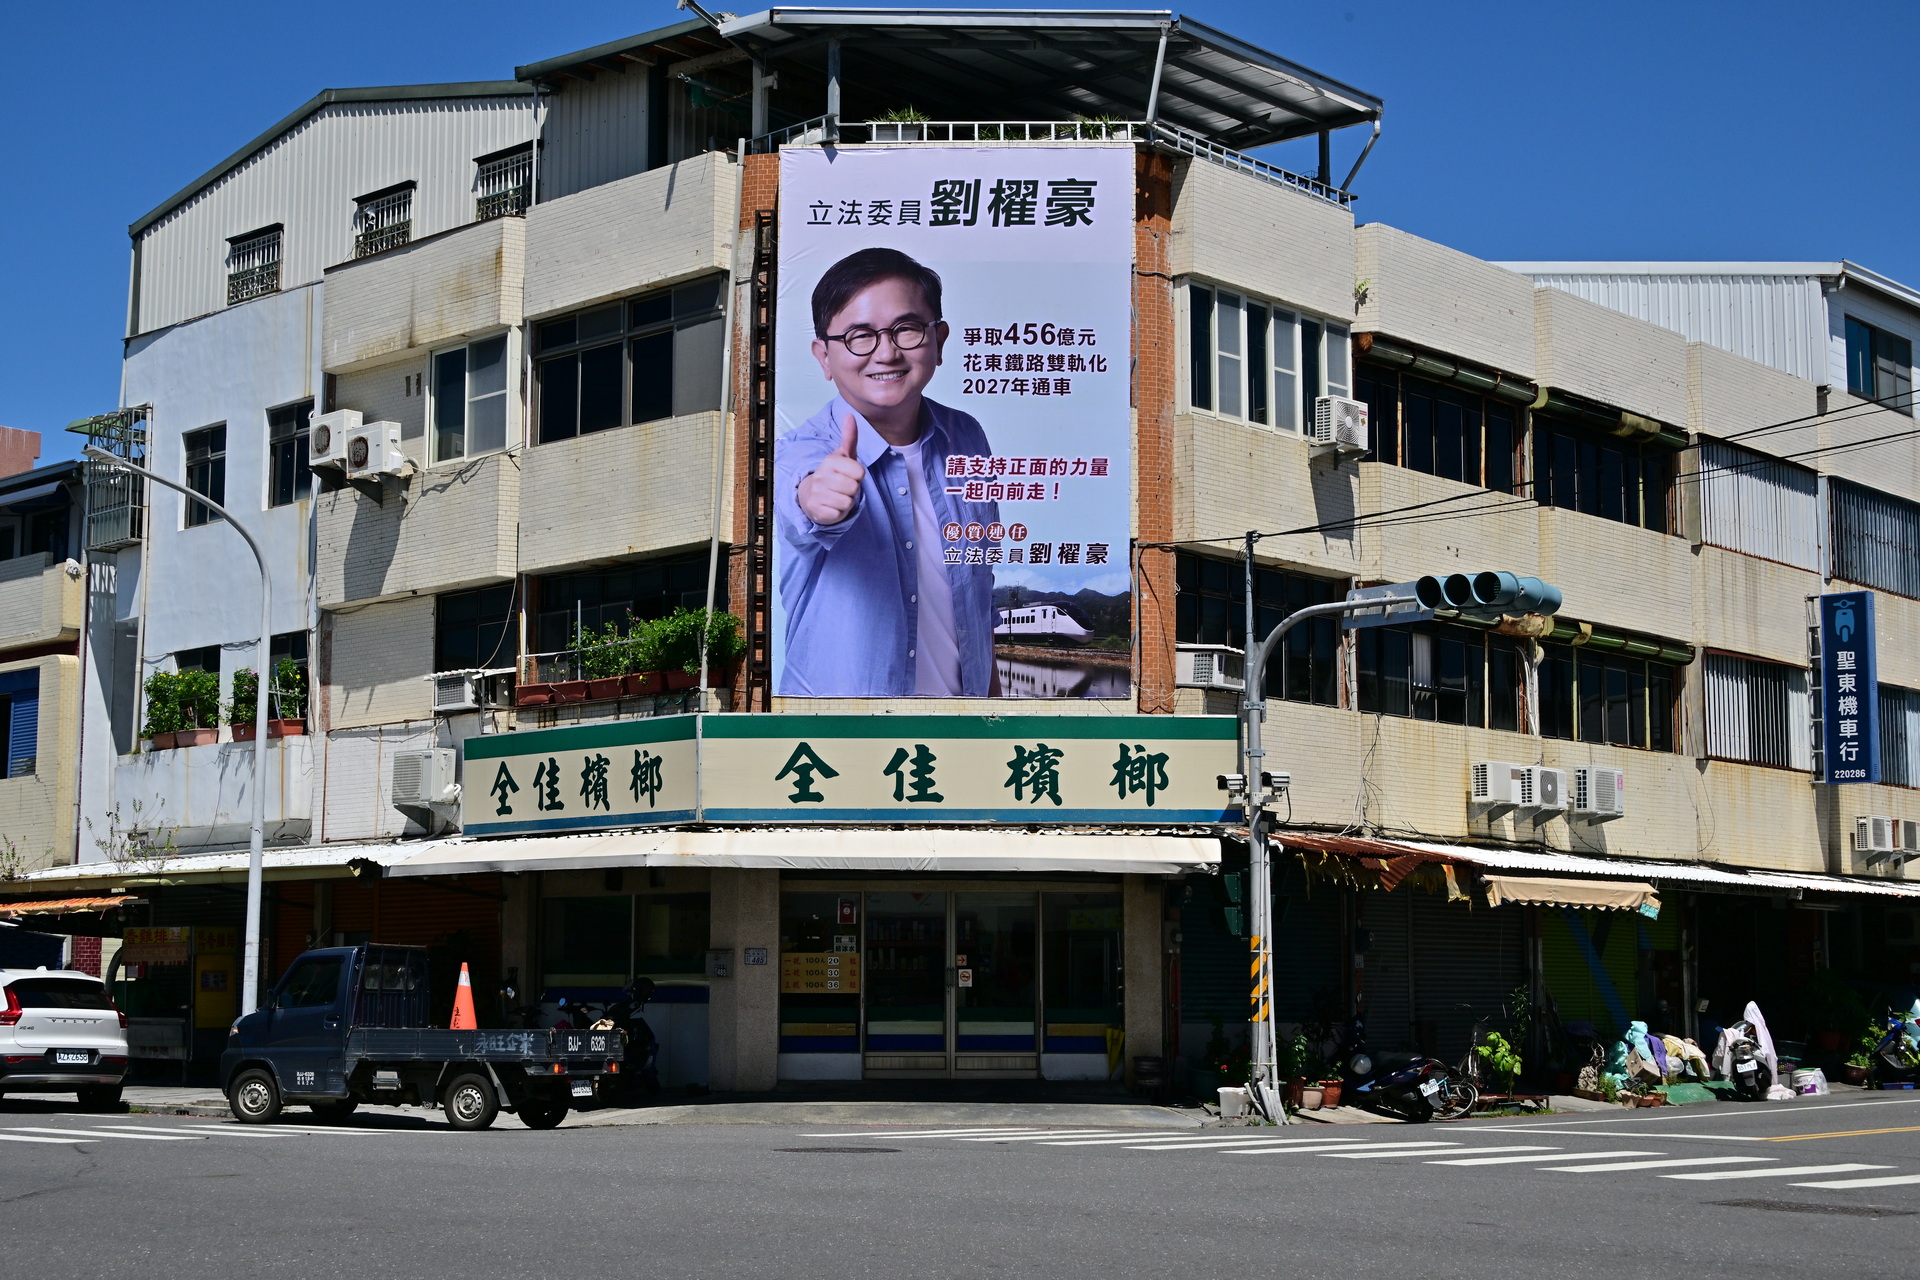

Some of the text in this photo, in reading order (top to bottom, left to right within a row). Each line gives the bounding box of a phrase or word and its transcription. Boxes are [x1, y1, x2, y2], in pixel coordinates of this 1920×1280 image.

[807, 178, 1098, 227] 立法委員 劉櫂豪
[963, 322, 1096, 346] 爭取456億元
[963, 353, 1108, 373] 花東鐵路雙軌化
[963, 377, 1072, 396] 2027年通車
[947, 457, 1109, 477] 請支持正面的力量
[945, 523, 1027, 541] 優質連任
[944, 542, 1110, 566] 立法委員 劉櫂豪
[1836, 650, 1860, 762] 聖東機車行
[490, 748, 663, 817] 全佳檳榔
[774, 741, 1170, 806] 全佳檳榔
[1834, 769, 1866, 779] 220286
[590, 1035, 606, 1052] 6326
